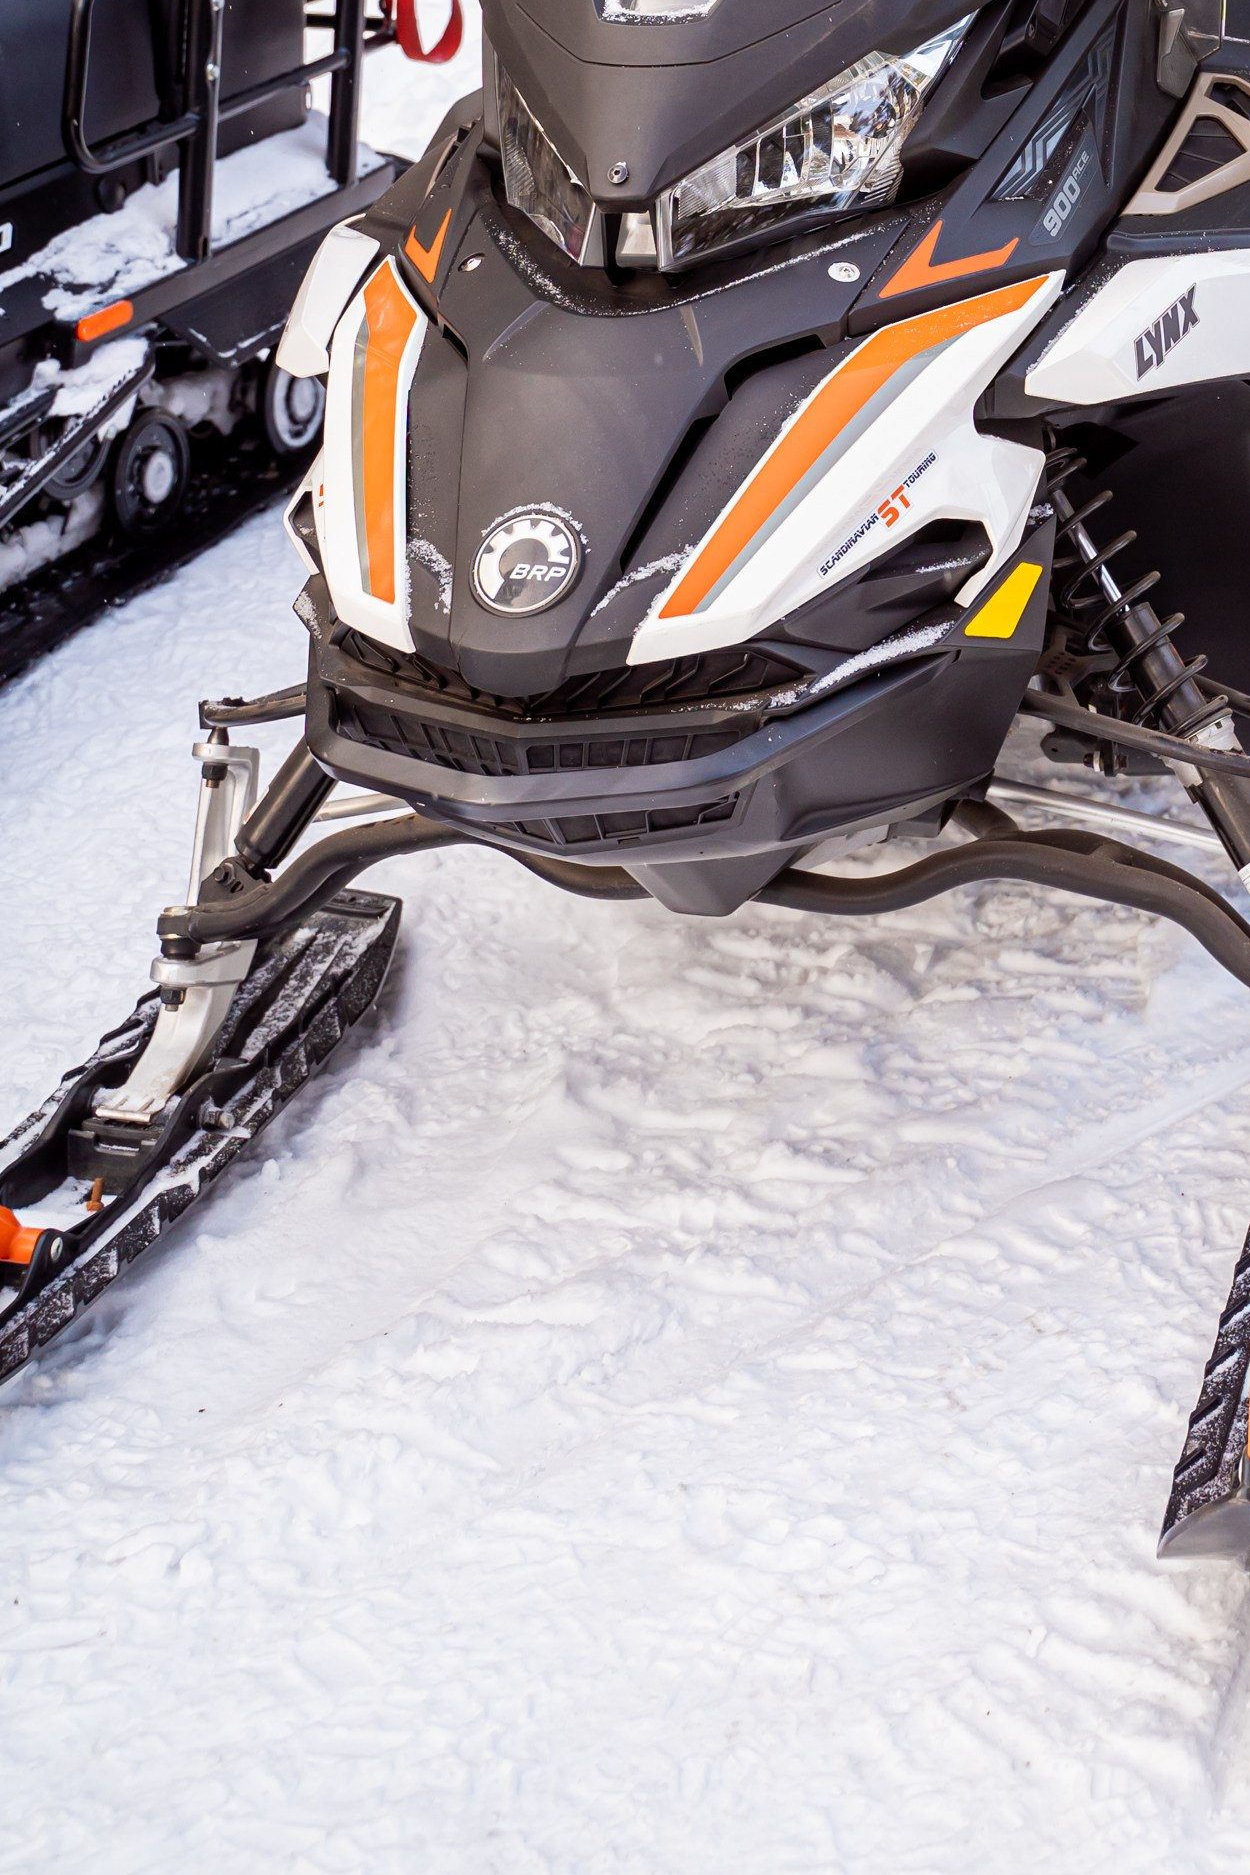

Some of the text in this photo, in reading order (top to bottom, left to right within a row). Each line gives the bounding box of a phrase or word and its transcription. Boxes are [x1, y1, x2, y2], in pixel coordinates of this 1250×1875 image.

[1043, 150, 1090, 237] 900 ACE
[1135, 285, 1199, 378] LYNX
[819, 452, 937, 576] SCANDINAVIAN ST TOURING
[509, 563, 567, 582] BRP
